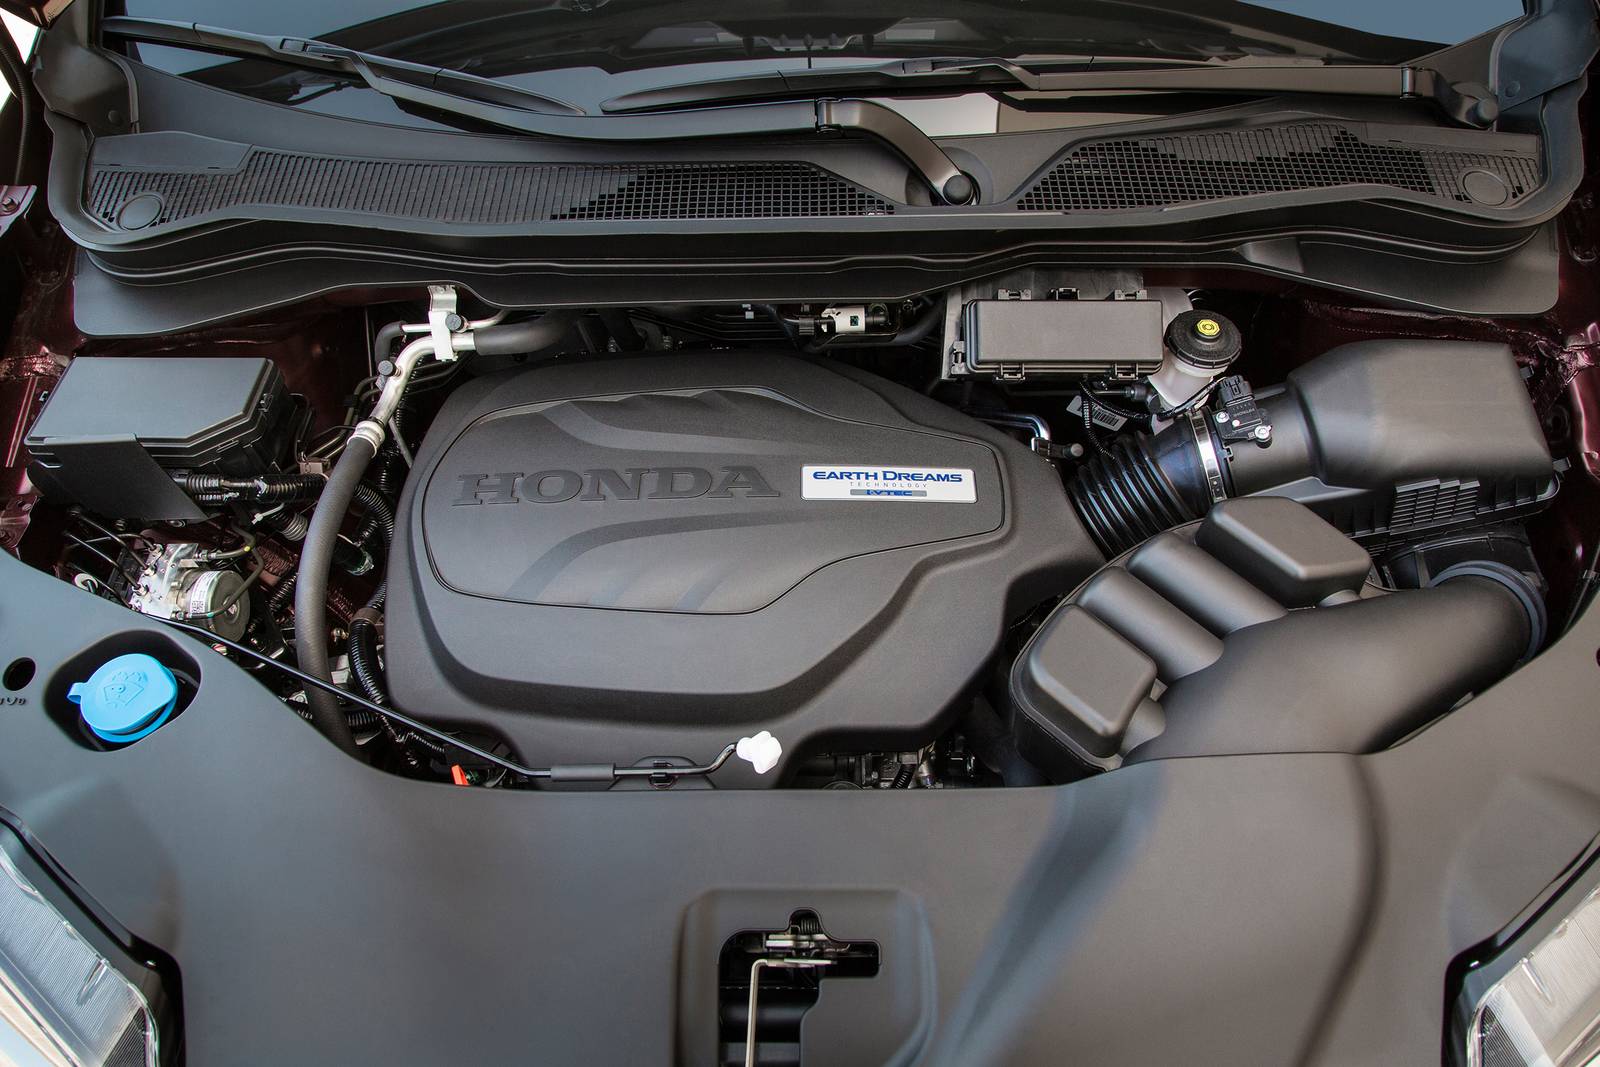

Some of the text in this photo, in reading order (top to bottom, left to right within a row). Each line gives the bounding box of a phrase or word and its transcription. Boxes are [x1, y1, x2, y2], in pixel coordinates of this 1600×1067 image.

[452, 465, 780, 506] HONDA
[813, 470, 963, 482] EARTH DREAMS
